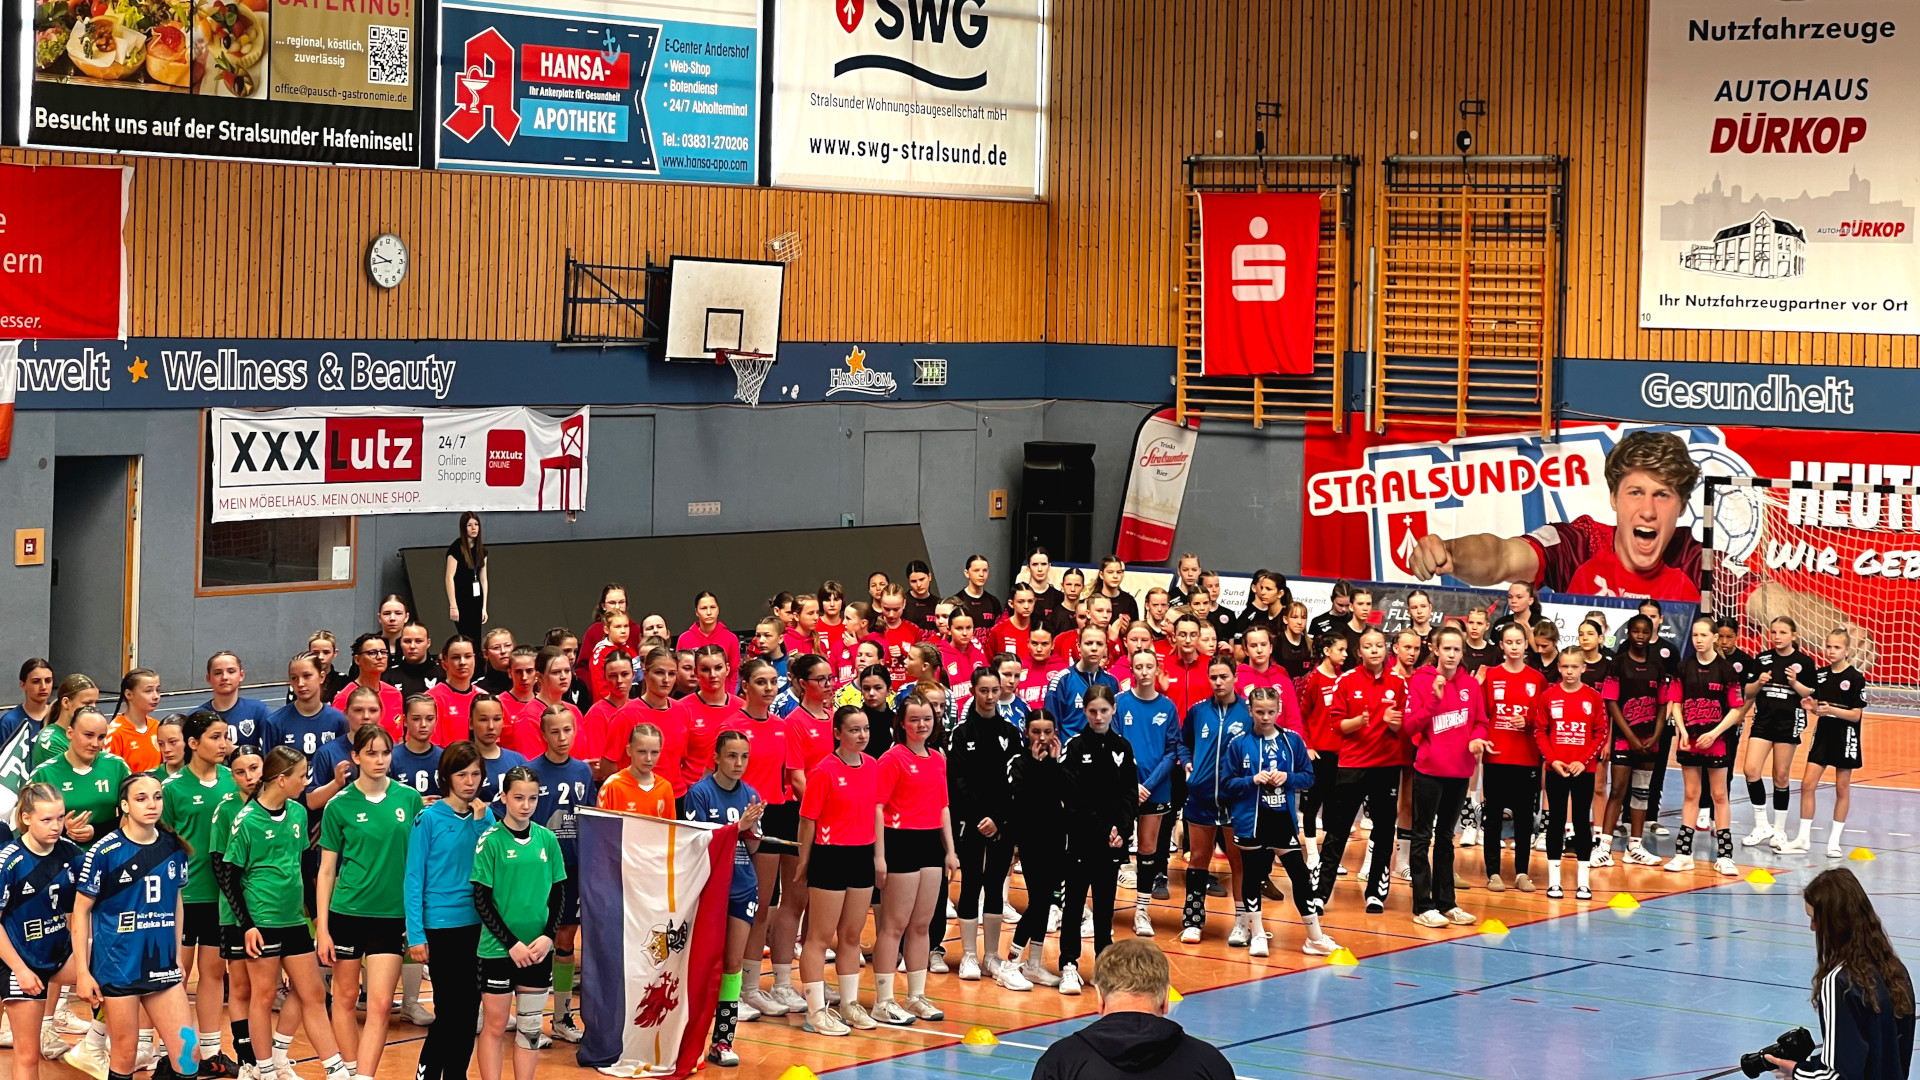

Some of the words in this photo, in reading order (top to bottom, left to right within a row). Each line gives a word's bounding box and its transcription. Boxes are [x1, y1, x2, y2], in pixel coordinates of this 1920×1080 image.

[875, 0, 988, 49] SWG
[1688, 17, 1896, 44] Nutzfahrzeuge
[286, 36, 326, 52] regional,
[327, 37, 364, 54] köstlich,
[664, 38, 703, 55] E-Center
[704, 41, 750, 59] Andershof
[294, 51, 345, 68] zuverlässig
[540, 52, 611, 81] HANSA-
[670, 60, 711, 77] Web-Shop
[275, 83, 408, 103] office@pausch-gastronomie.de
[529, 86, 538, 97] Ihr
[539, 87, 574, 100] Ankerplatz
[575, 88, 585, 100] für
[585, 90, 621, 102] Gesundheit
[670, 81, 718, 96] Botendienst
[1714, 78, 1869, 102] AUTOHAUS
[669, 100, 690, 113] 24/7
[691, 102, 748, 118] Abholterminal
[810, 93, 865, 110] Stralsunder
[867, 98, 985, 120] Wohnungsbaugesellschaft
[987, 108, 1008, 121] mbH
[35, 106, 110, 133] Besucht
[115, 117, 149, 136] uns
[152, 117, 181, 138] auf
[184, 121, 216, 141] der
[219, 123, 318, 148] Stralsunder
[323, 127, 413, 152] Hafeninsel!
[534, 107, 617, 135] APOTHEKE
[662, 132, 681, 148] Tel.:
[682, 134, 749, 151] 03831-270206
[1710, 113, 1867, 154] DÜRKOP
[810, 137, 1008, 166] www.swg-stralsund.de
[662, 155, 749, 172] www.hansa-apo.com
[1839, 220, 1905, 238] DÜRKOP
[3, 252, 43, 274] ern
[1659, 294, 1680, 307] Ihr
[1685, 295, 1847, 312] Nutzfahrzeugpartner
[1852, 300, 1877, 311] vor
[1883, 299, 1909, 311] Ort
[0, 314, 42, 329] esser.
[161, 349, 308, 391] Wellness
[318, 352, 345, 391] &
[351, 352, 457, 398] Beauty
[1641, 373, 1854, 414] Gesundheit
[230, 428, 414, 473] XXXLutz
[438, 435, 466, 450] 24/7
[438, 454, 467, 467] Online
[488, 460, 511, 469] ONLINE
[489, 450, 523, 460] XXXLutz
[1140, 447, 1189, 467] Stralsunder
[438, 468, 481, 483] Shopping
[1313, 453, 1590, 510] STRALSUNDER
[219, 498, 248, 510] MEIN
[250, 493, 320, 509] MÖBELHAUS.
[322, 492, 348, 505] MEIN
[351, 491, 389, 504] ONLINE
[391, 490, 421, 504] SHOP.
[1767, 538, 1840, 576] WIR
[1220, 598, 1247, 607] Korall
[1223, 589, 1245, 597] Sund
[1556, 721, 1587, 733] K-PI
[303, 733, 317, 754] 8
[95, 779, 110, 793] 11
[415, 770, 429, 791] 6
[558, 783, 570, 805] 2
[395, 808, 404, 822] 9
[292, 824, 300, 838] 3
[539, 848, 547, 863] 4
